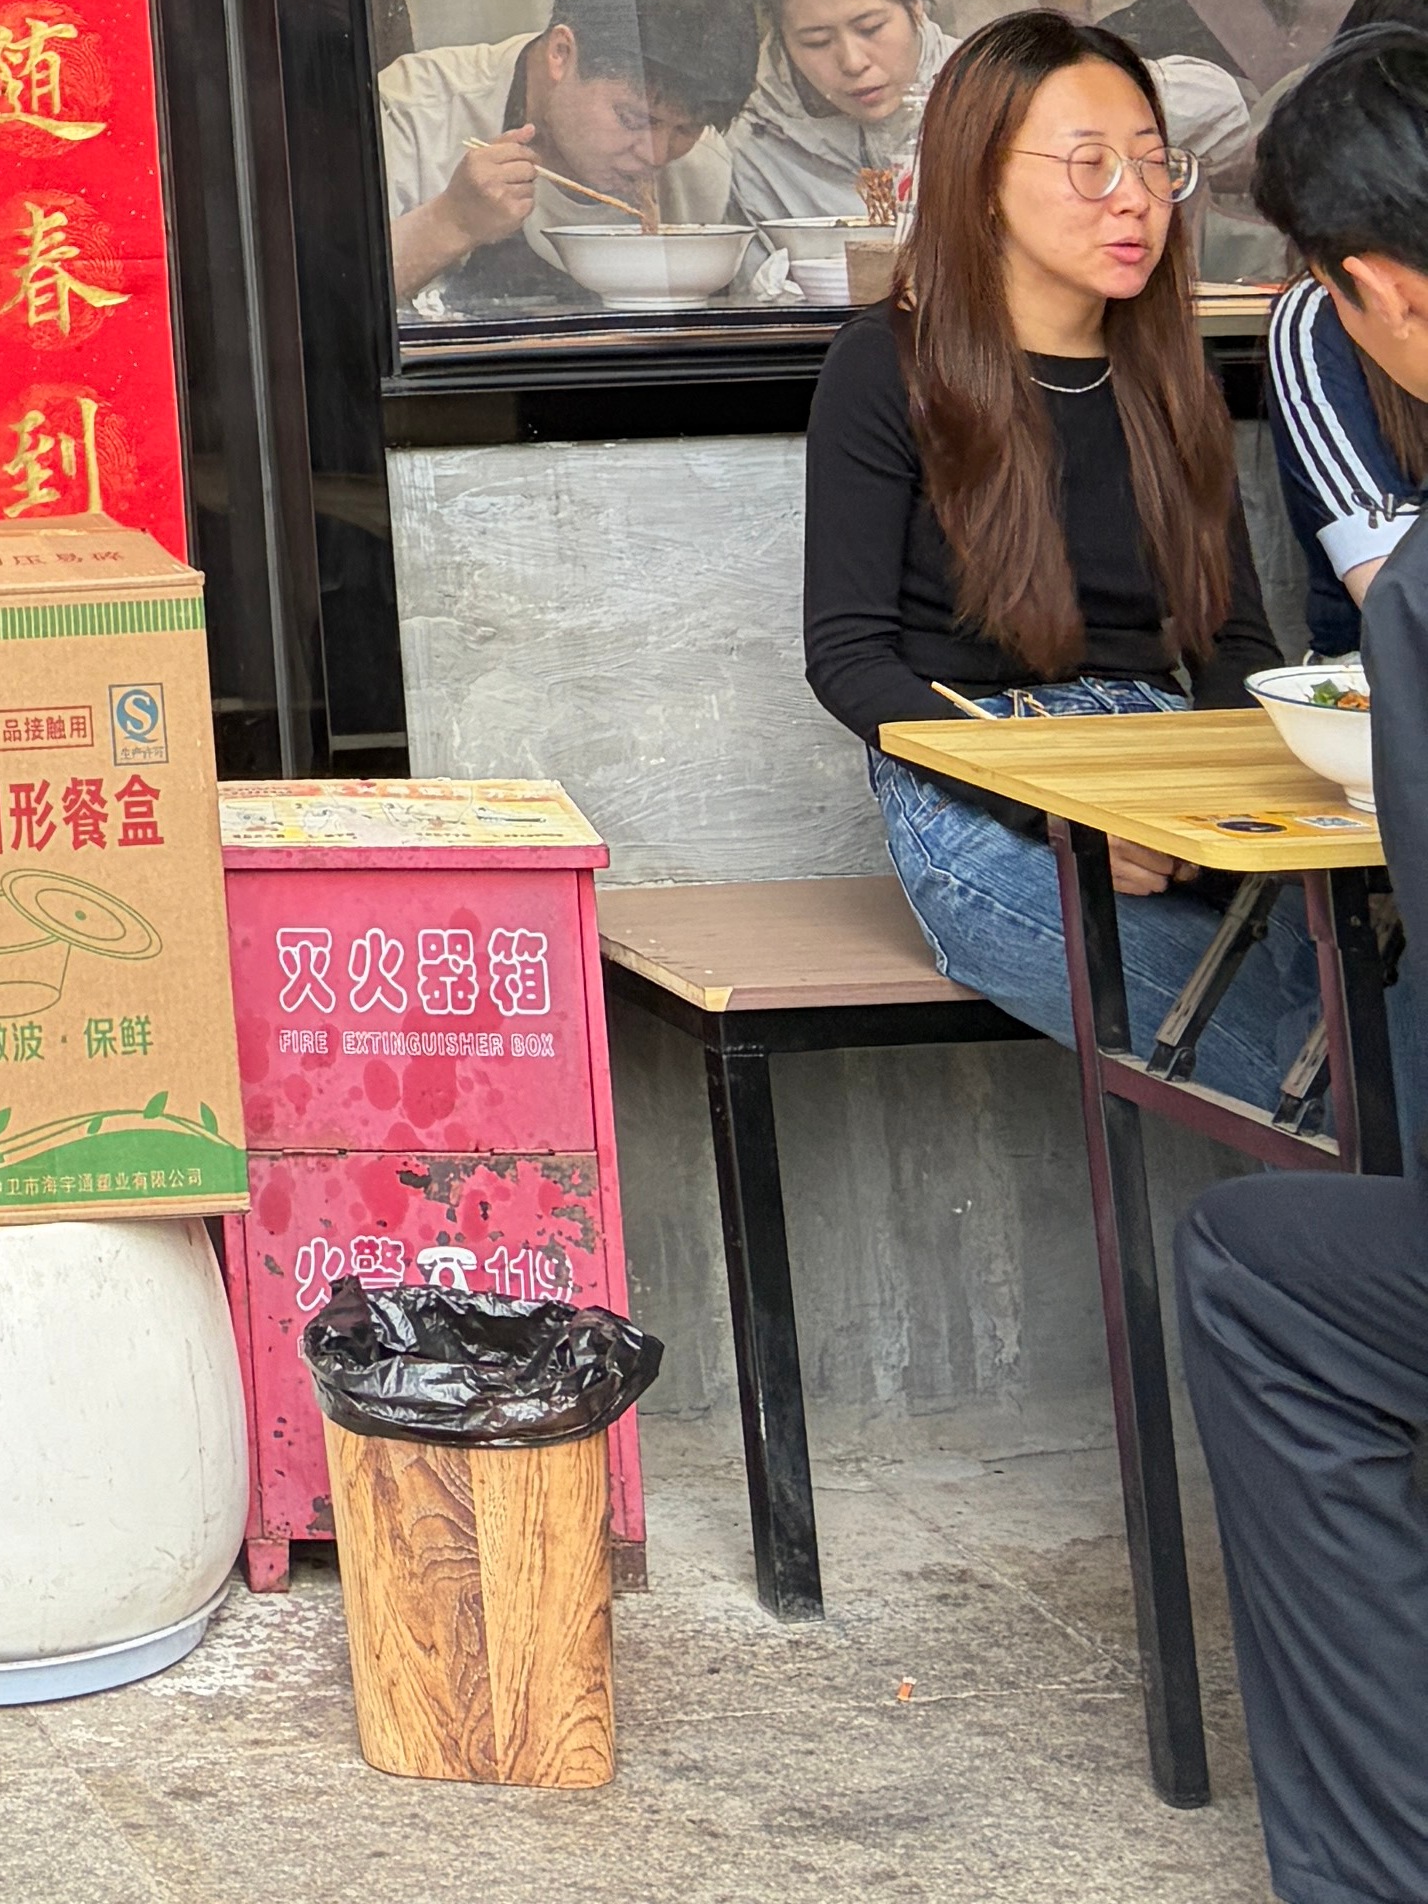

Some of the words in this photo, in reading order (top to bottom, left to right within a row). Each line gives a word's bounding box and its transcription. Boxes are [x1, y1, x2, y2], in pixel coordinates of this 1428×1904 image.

[277, 927, 550, 1015] 灭火器箱
[279, 1029, 329, 1054] FIRE
[342, 1031, 504, 1057] EXTINGUISHER
[510, 1033, 555, 1057] BOX
[484, 1245, 573, 1302] 119
